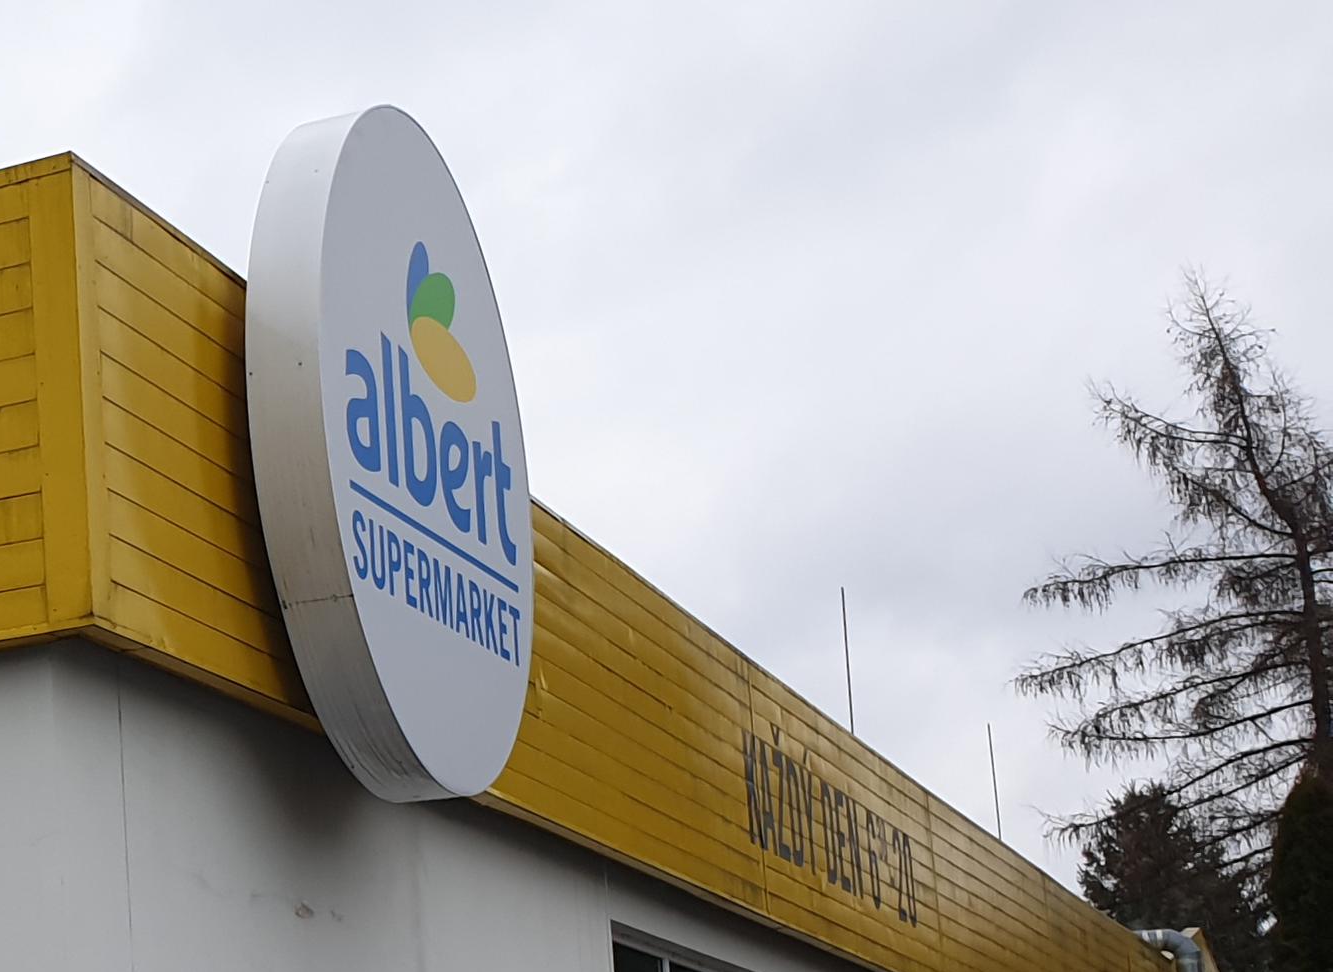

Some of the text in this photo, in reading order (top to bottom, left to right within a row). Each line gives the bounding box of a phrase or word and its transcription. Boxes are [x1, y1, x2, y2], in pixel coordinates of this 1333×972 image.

[345, 331, 517, 567] albert
[351, 510, 521, 667] SUPERMARKET
[741, 722, 817, 876] KAŽDÝ
[820, 778, 864, 900] DEN
